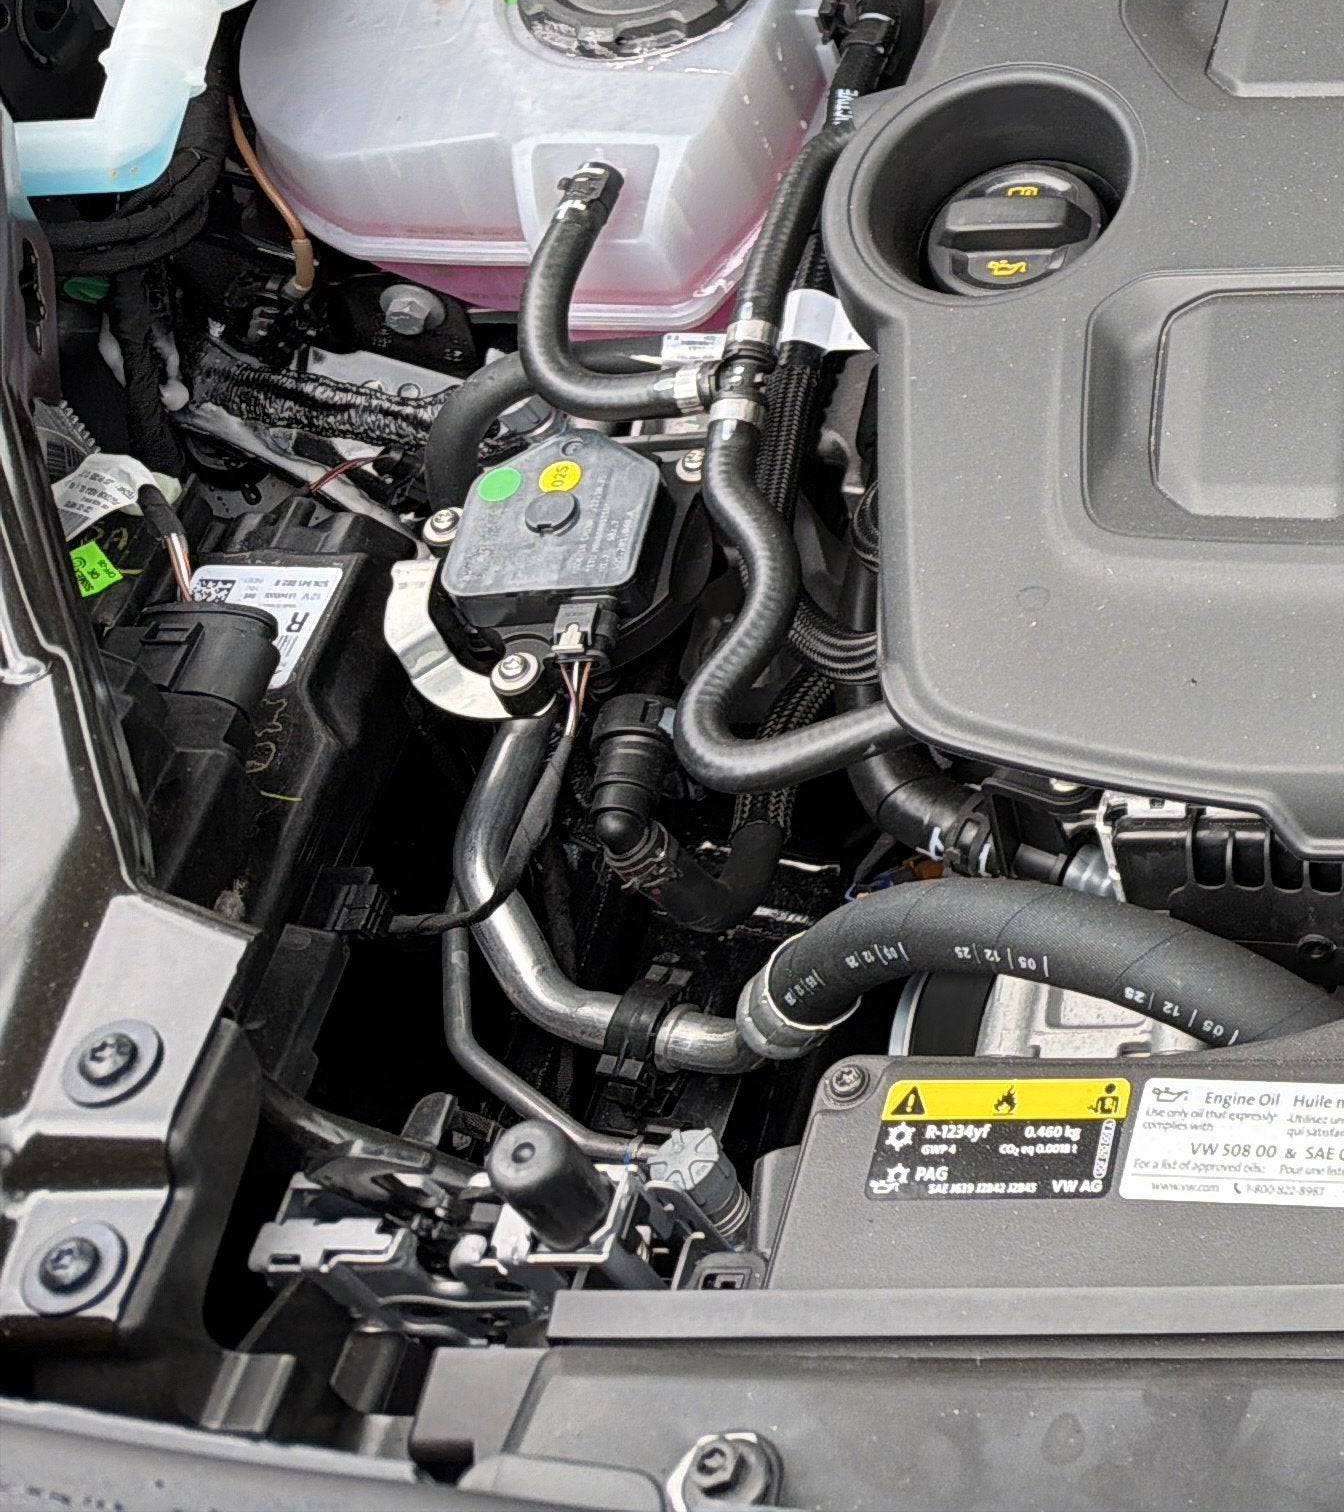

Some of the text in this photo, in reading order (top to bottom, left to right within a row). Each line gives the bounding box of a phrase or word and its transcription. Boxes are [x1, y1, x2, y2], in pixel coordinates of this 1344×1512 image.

[286, 612, 310, 633] R
[954, 946, 1036, 970] 05 12 25
[1124, 986, 1224, 1037] 05 12 25
[1205, 1092, 1280, 1109] Engine Oil
[1293, 1094, 1333, 1109] Huile
[1145, 1107, 1278, 1124] Use only oil that expressly
[926, 1123, 1082, 1142] R-1234yf 0.460 kg
[1142, 1120, 1214, 1132] complies with
[1287, 1125, 1304, 1138] qui
[921, 1144, 946, 1155] GWP
[947, 1144, 957, 1155] 4
[1191, 1142, 1219, 1156] VW
[1222, 1143, 1251, 1157] 508
[1255, 1145, 1277, 1158] 00
[1285, 1148, 1297, 1159] &
[1305, 1147, 1335, 1160] SAE
[914, 1166, 949, 1182] PAG
[1133, 1158, 1149, 1169] For
[1161, 1159, 1178, 1170] list
[1179, 1160, 1192, 1170] of
[1192, 1161, 1241, 1174] approved
[1280, 1164, 1303, 1175] Pour
[1305, 1166, 1325, 1176] une
[1051, 1179, 1079, 1193] VW
[1079, 1179, 1104, 1193] AG
